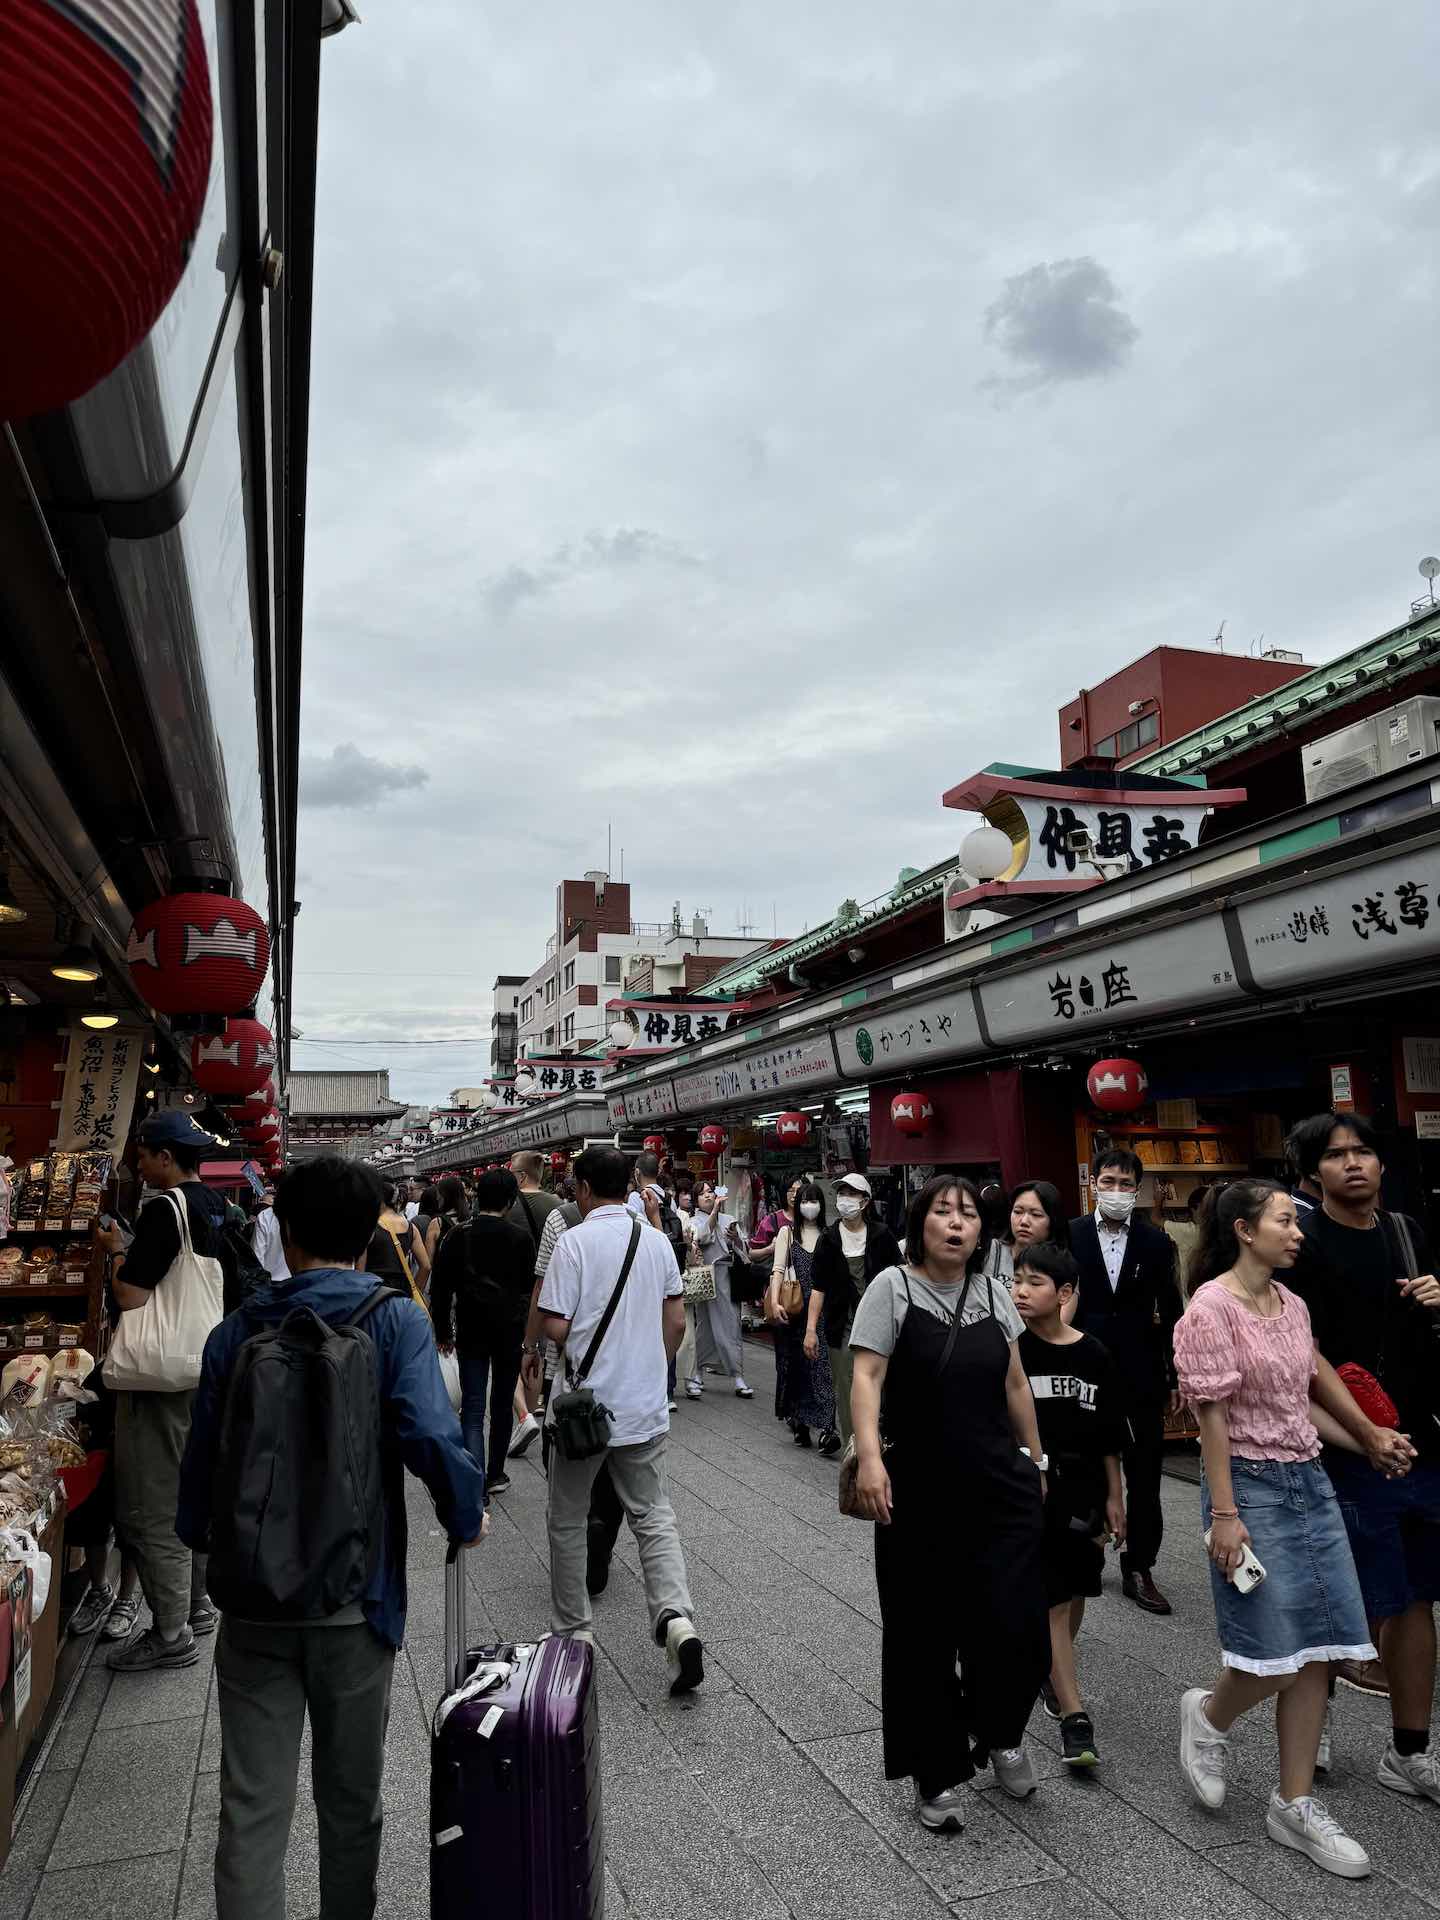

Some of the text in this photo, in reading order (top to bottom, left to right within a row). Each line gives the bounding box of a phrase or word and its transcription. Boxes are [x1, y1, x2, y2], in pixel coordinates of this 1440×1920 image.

[1352, 881, 1440, 939] 浅草
[643, 1012, 722, 1044] 仲見世
[540, 1067, 597, 1090] 仲見世
